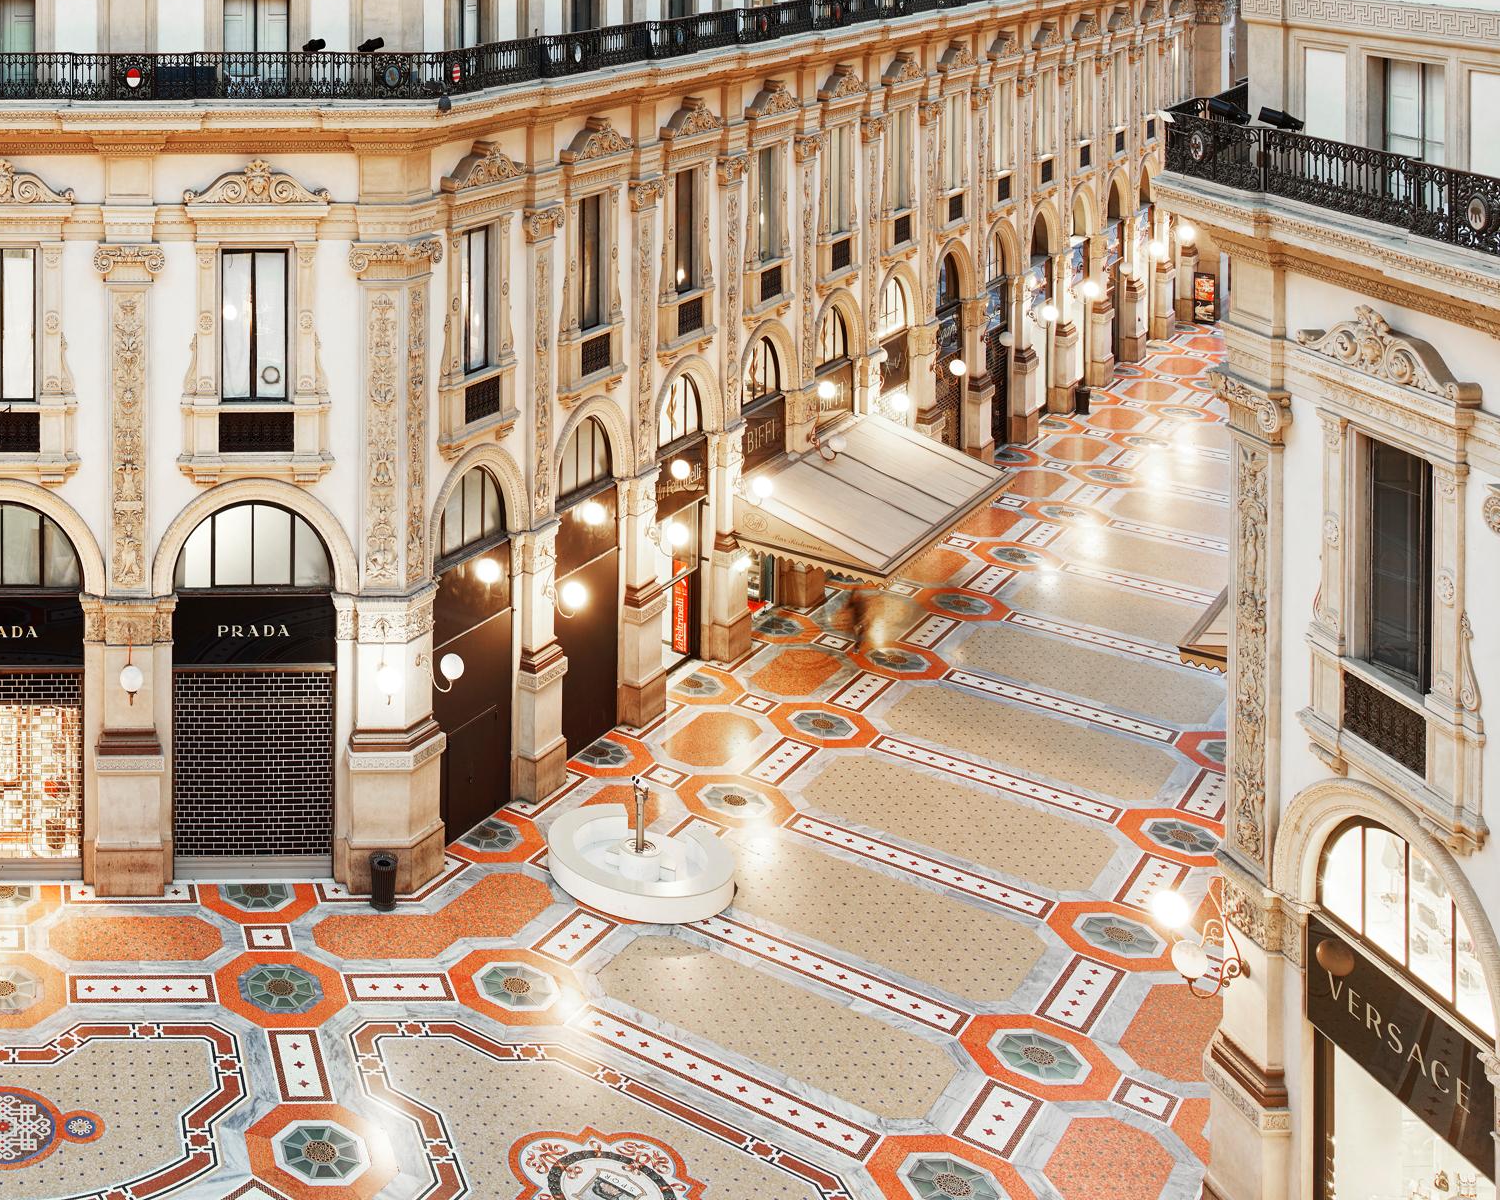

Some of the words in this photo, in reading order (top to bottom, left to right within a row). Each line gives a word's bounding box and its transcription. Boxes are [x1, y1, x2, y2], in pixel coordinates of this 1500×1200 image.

[747, 418, 776, 454] BIFFI
[217, 624, 291, 638] PRADA
[1327, 970, 1471, 1115] VERSACE
